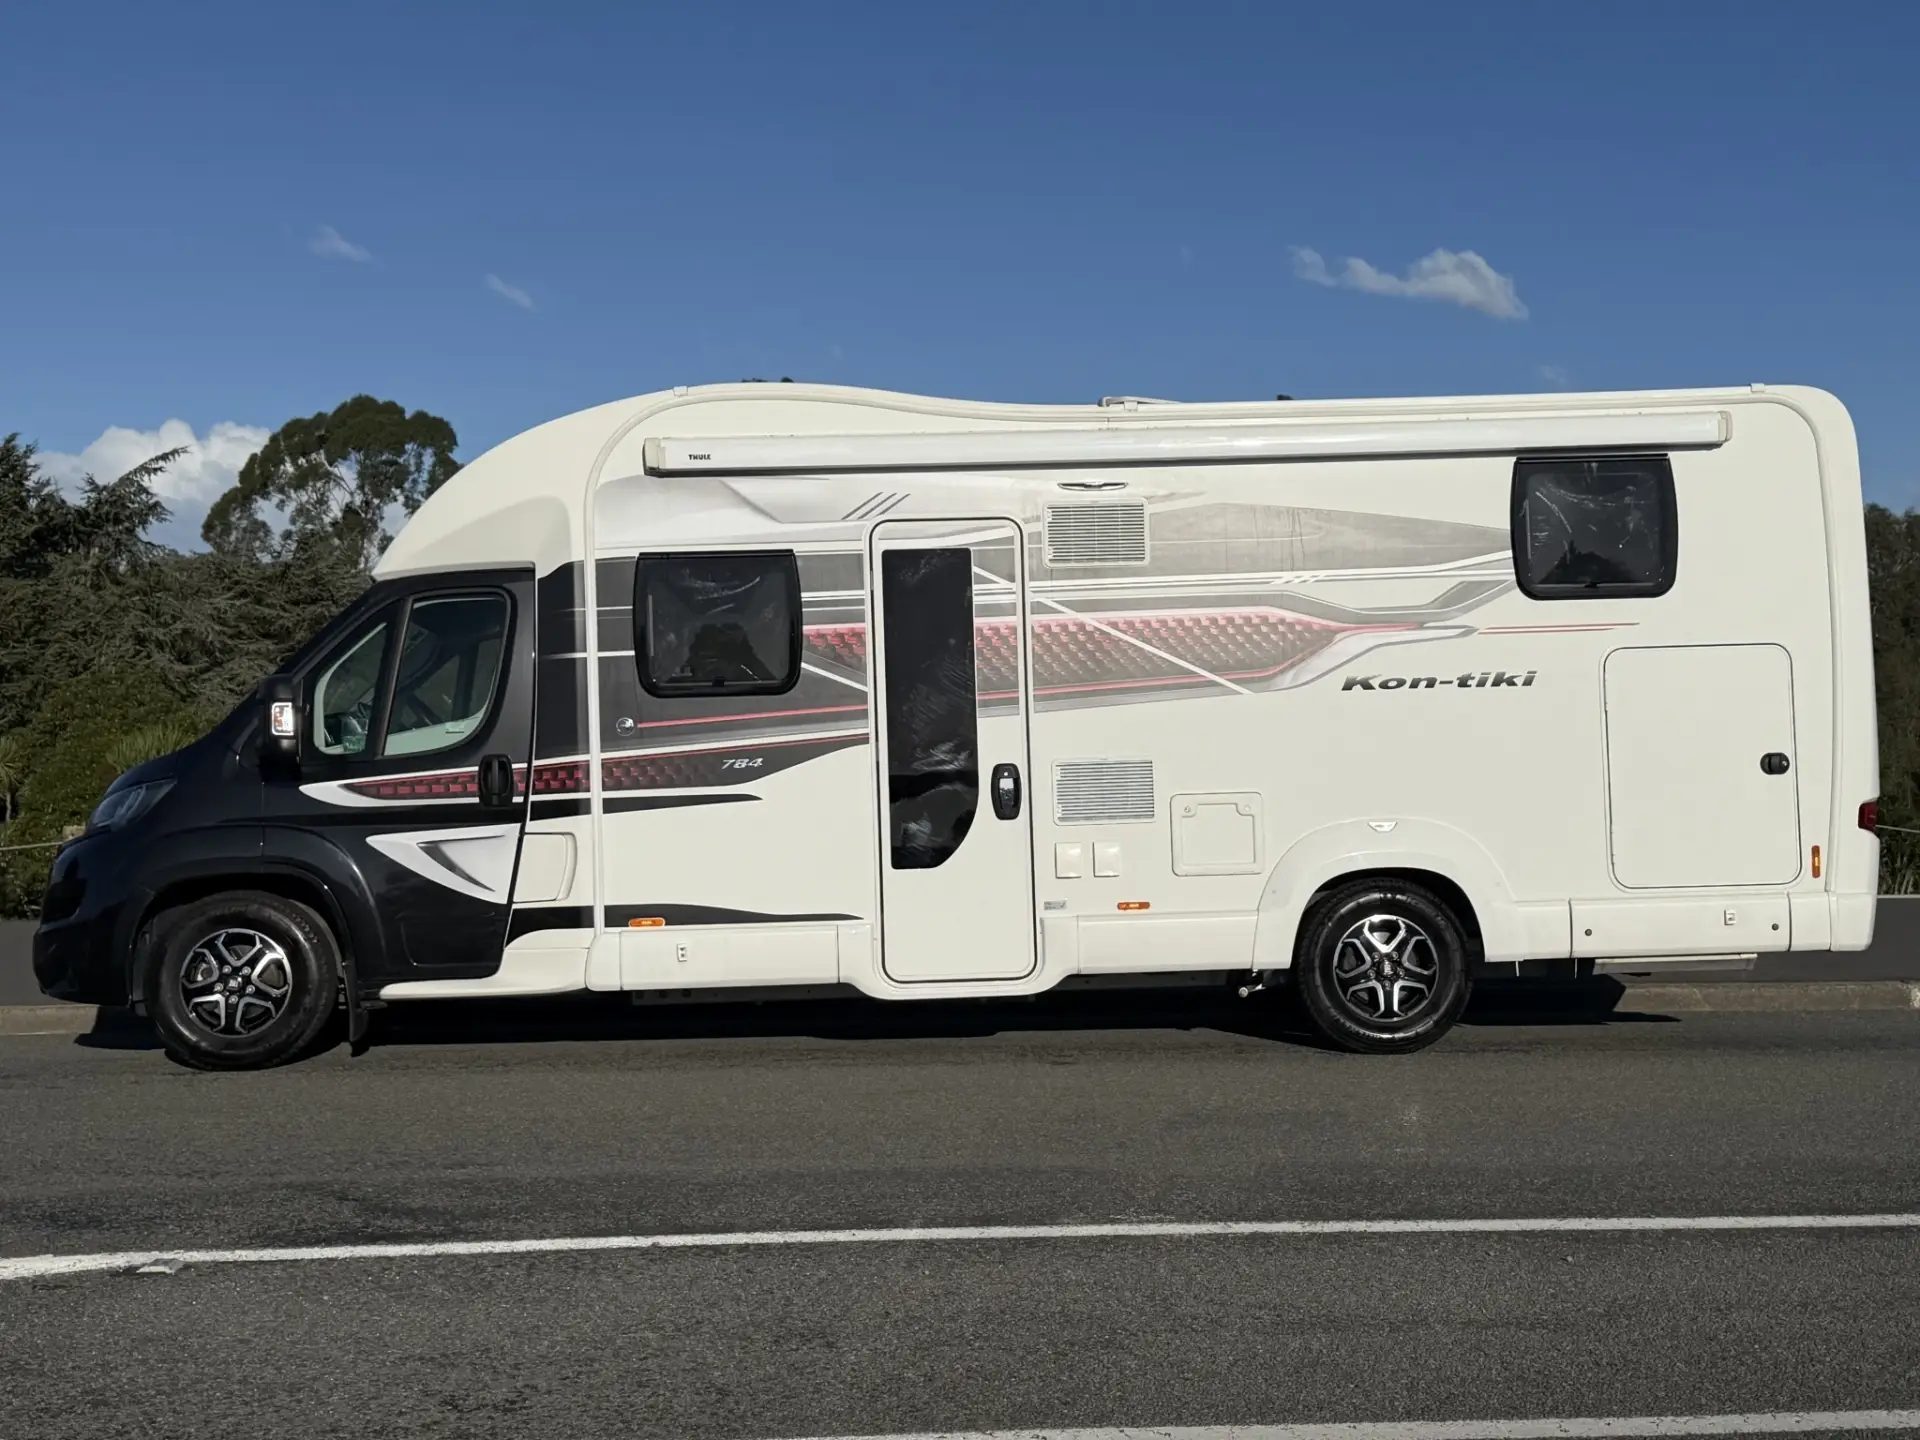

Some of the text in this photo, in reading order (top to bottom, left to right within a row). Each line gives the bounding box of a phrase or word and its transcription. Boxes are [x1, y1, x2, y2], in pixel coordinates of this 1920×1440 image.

[688, 453, 712, 461] THULE
[1341, 671, 1538, 691] Kon-tiki
[721, 757, 764, 770] 784
